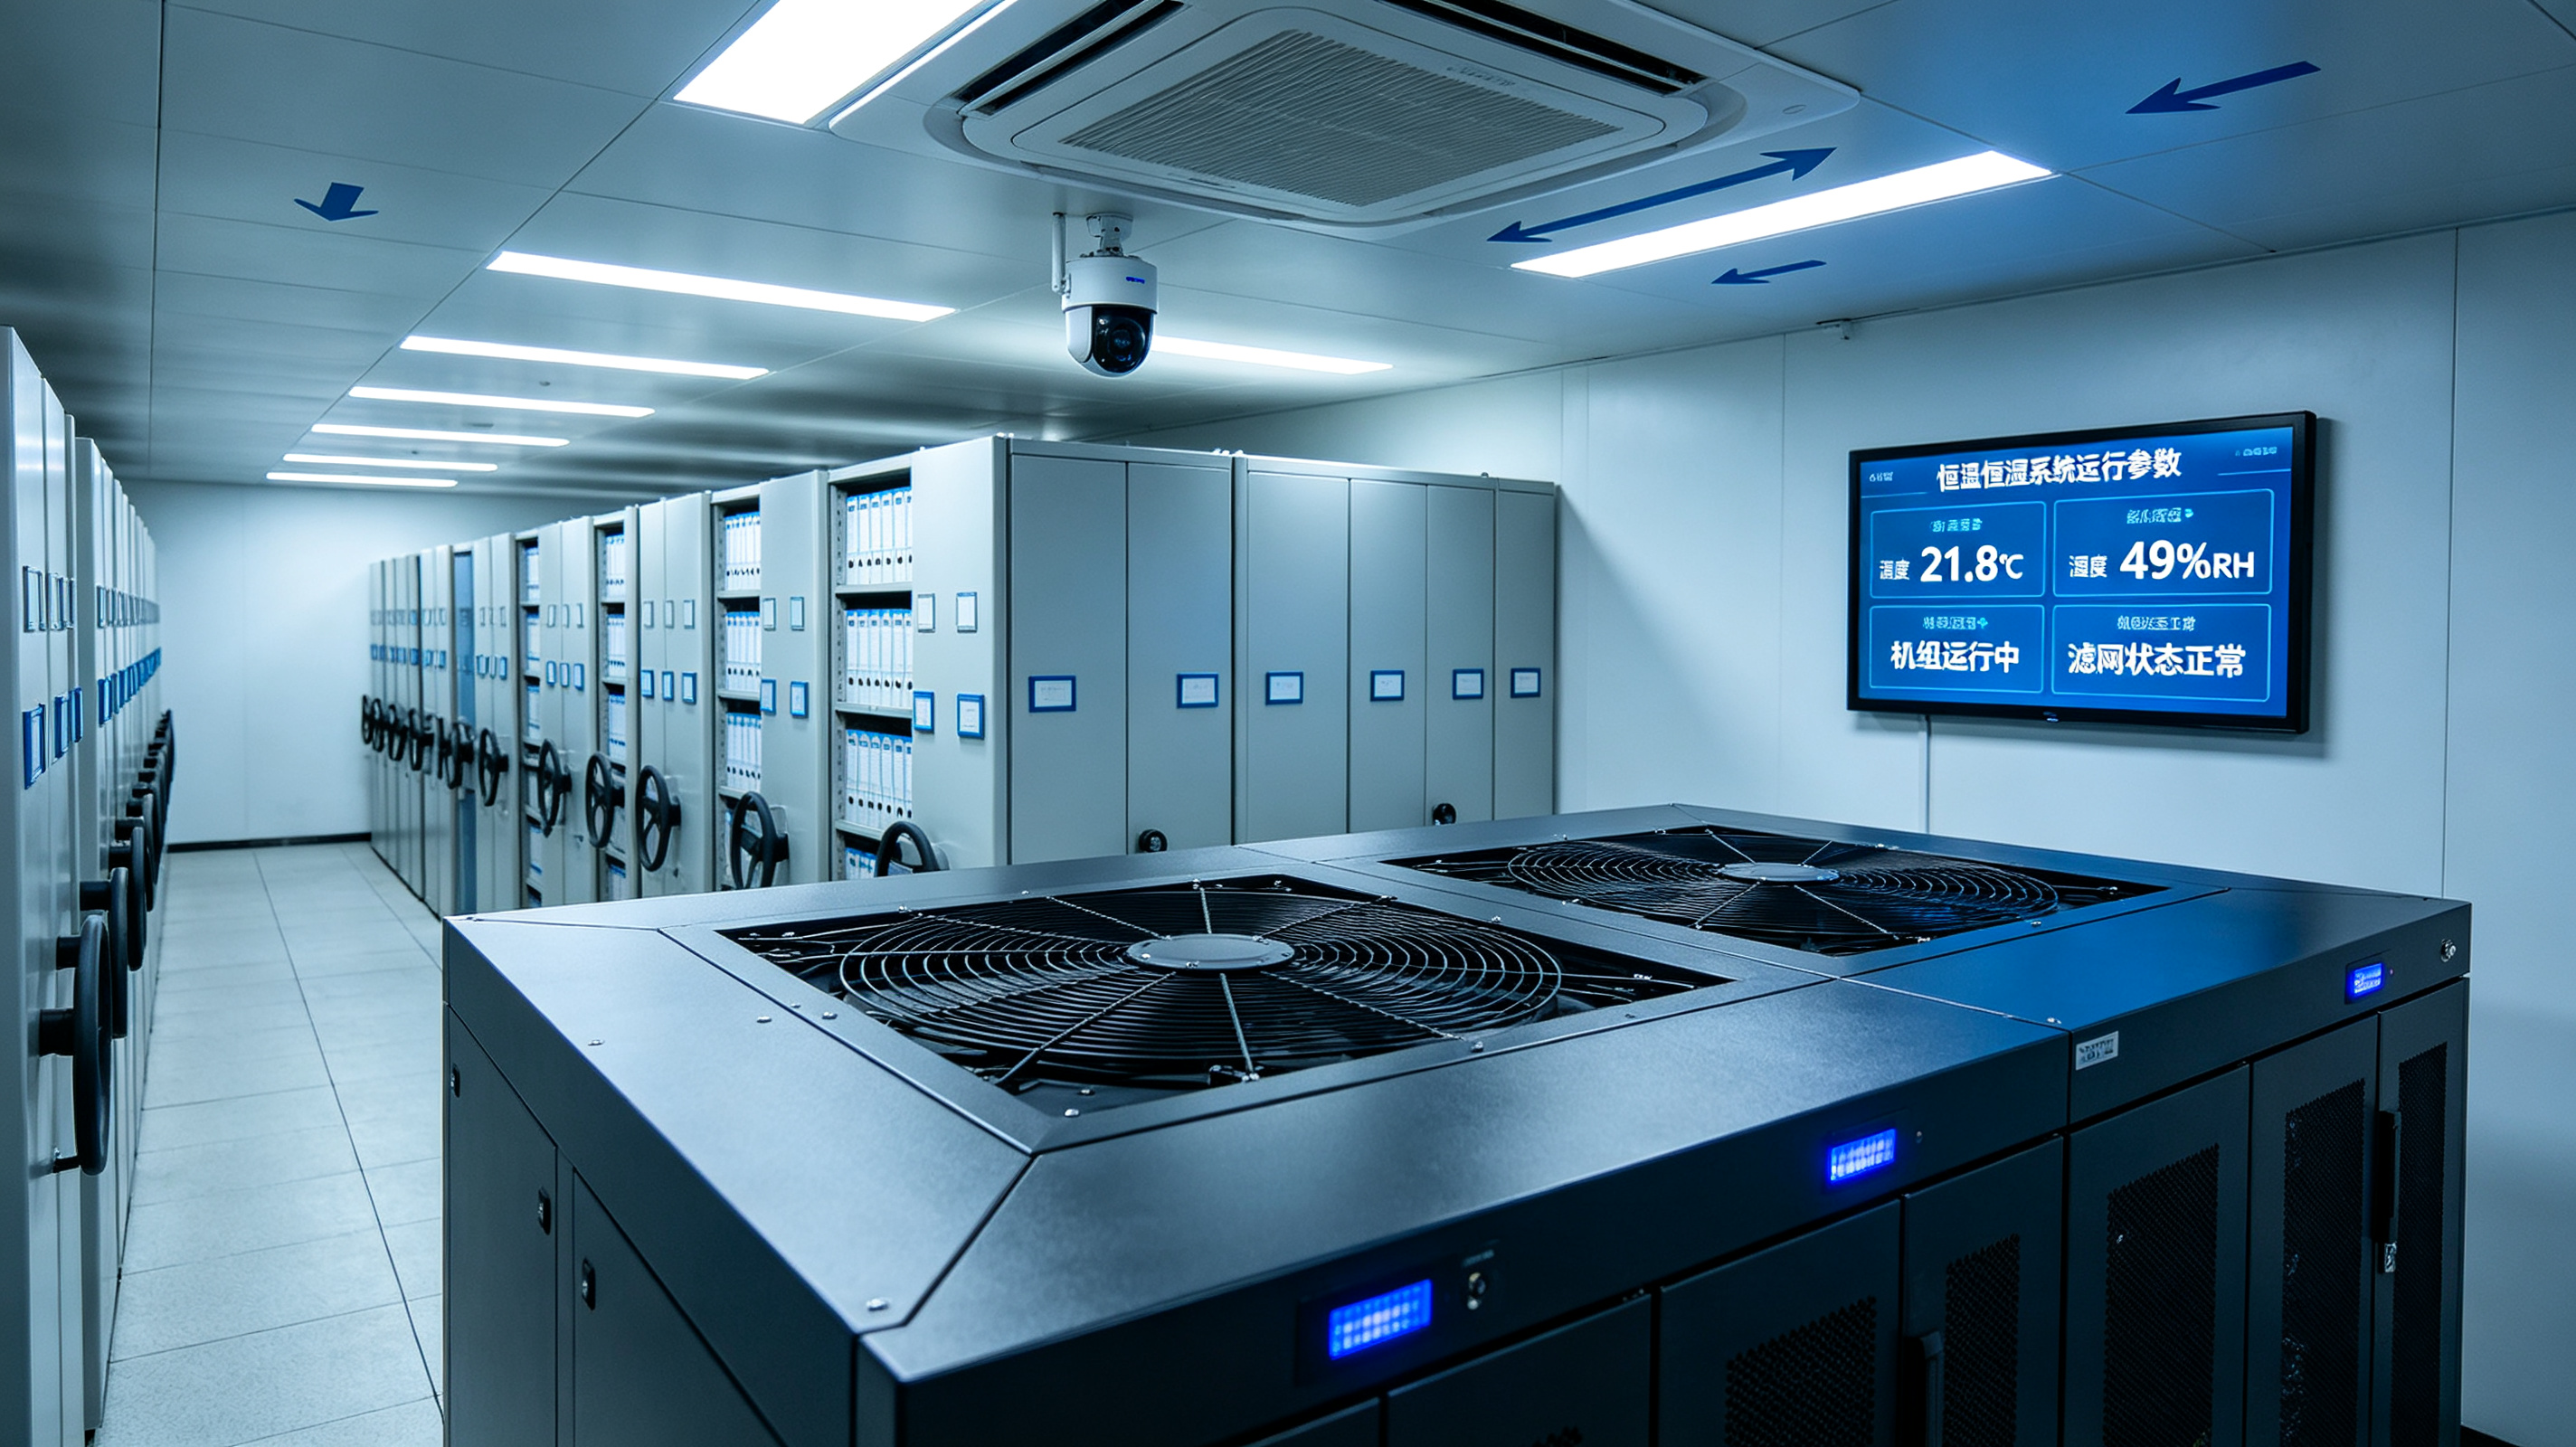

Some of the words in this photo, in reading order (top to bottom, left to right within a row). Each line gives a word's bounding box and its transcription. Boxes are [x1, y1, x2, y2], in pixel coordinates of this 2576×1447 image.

[2119, 540, 2255, 580] 49%RH
[1890, 640, 2019, 673] 机组运行中
[2068, 642, 2246, 678] 滤网状态正常
